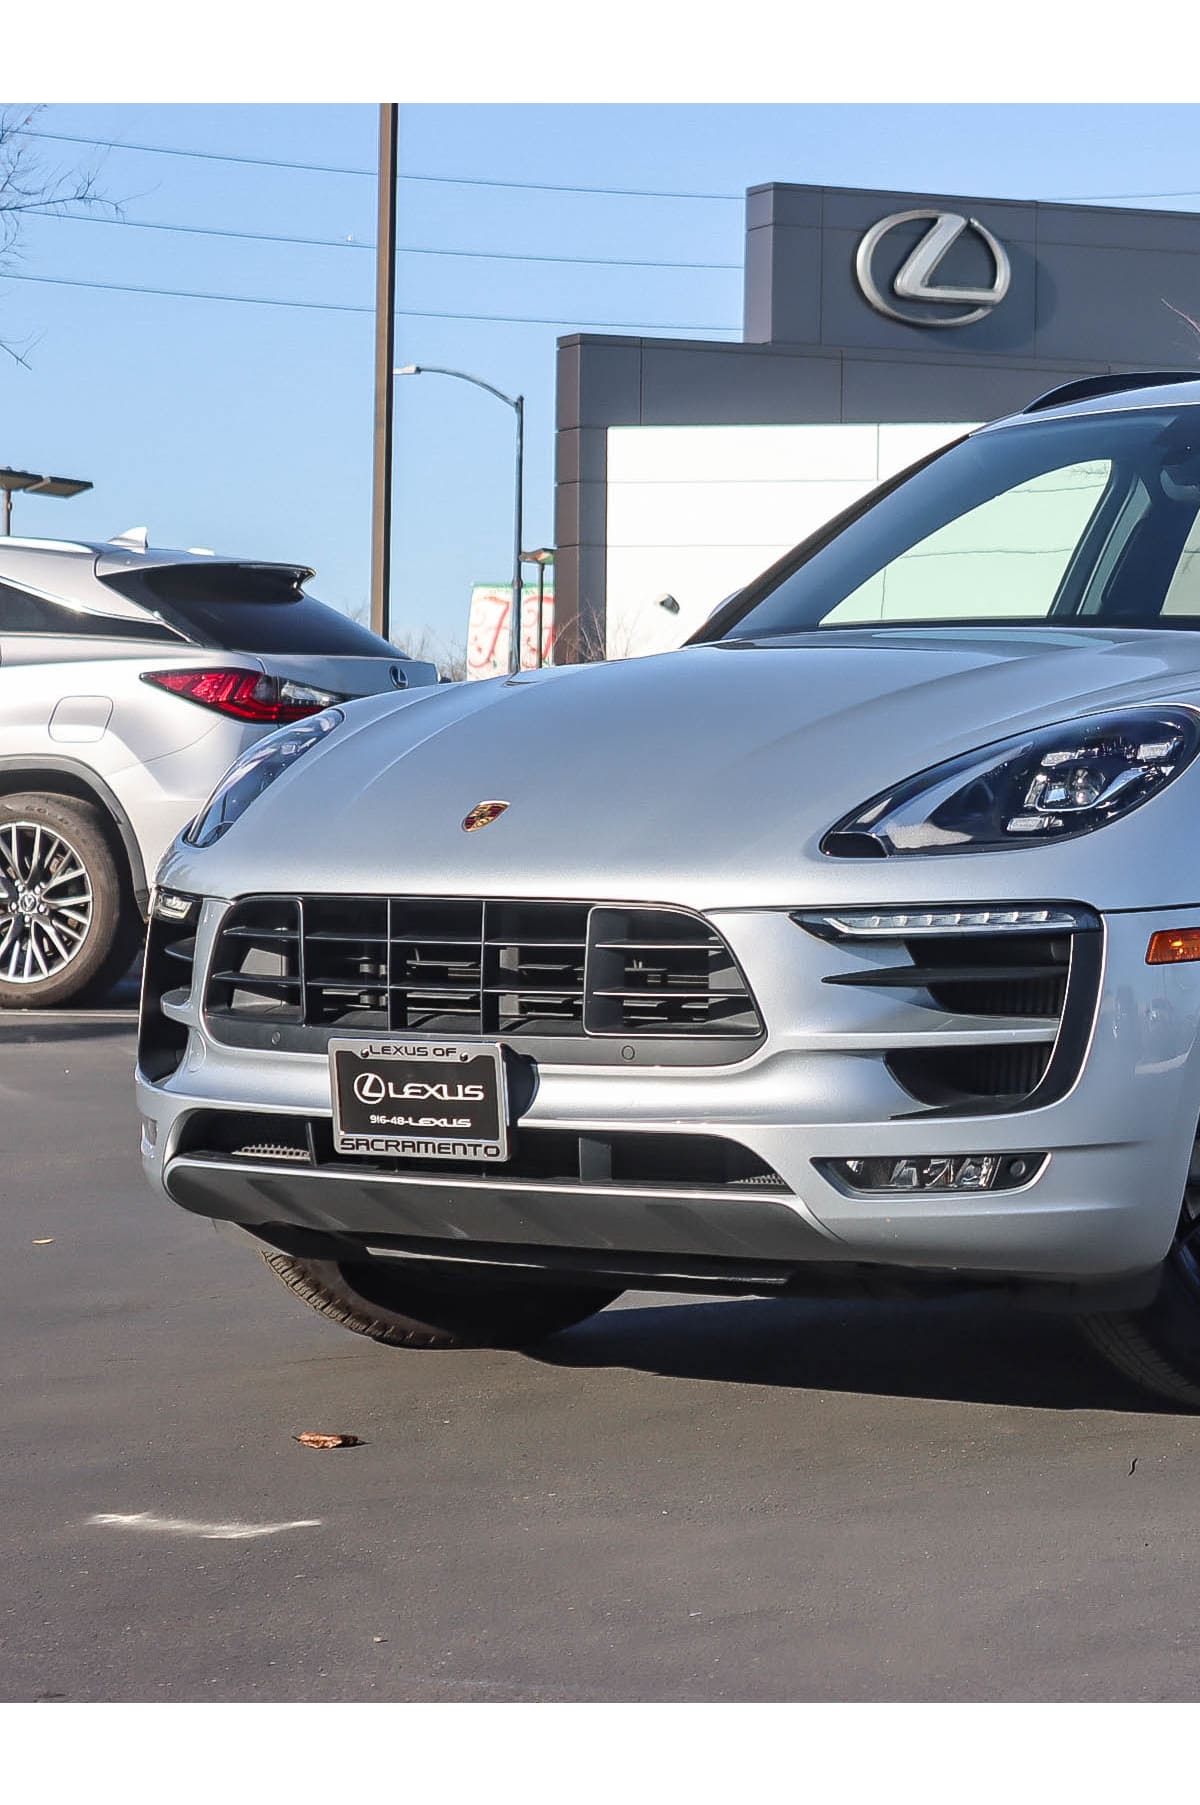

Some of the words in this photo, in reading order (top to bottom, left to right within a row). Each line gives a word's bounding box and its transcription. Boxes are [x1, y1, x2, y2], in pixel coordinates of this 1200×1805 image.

[369, 1044, 428, 1056] LEXUS
[433, 1047, 457, 1058] OF
[387, 1081, 485, 1101] LEXUS
[369, 1114, 472, 1128] 916-48-LEXUS
[340, 1138, 500, 1158] SACRAMENTO
